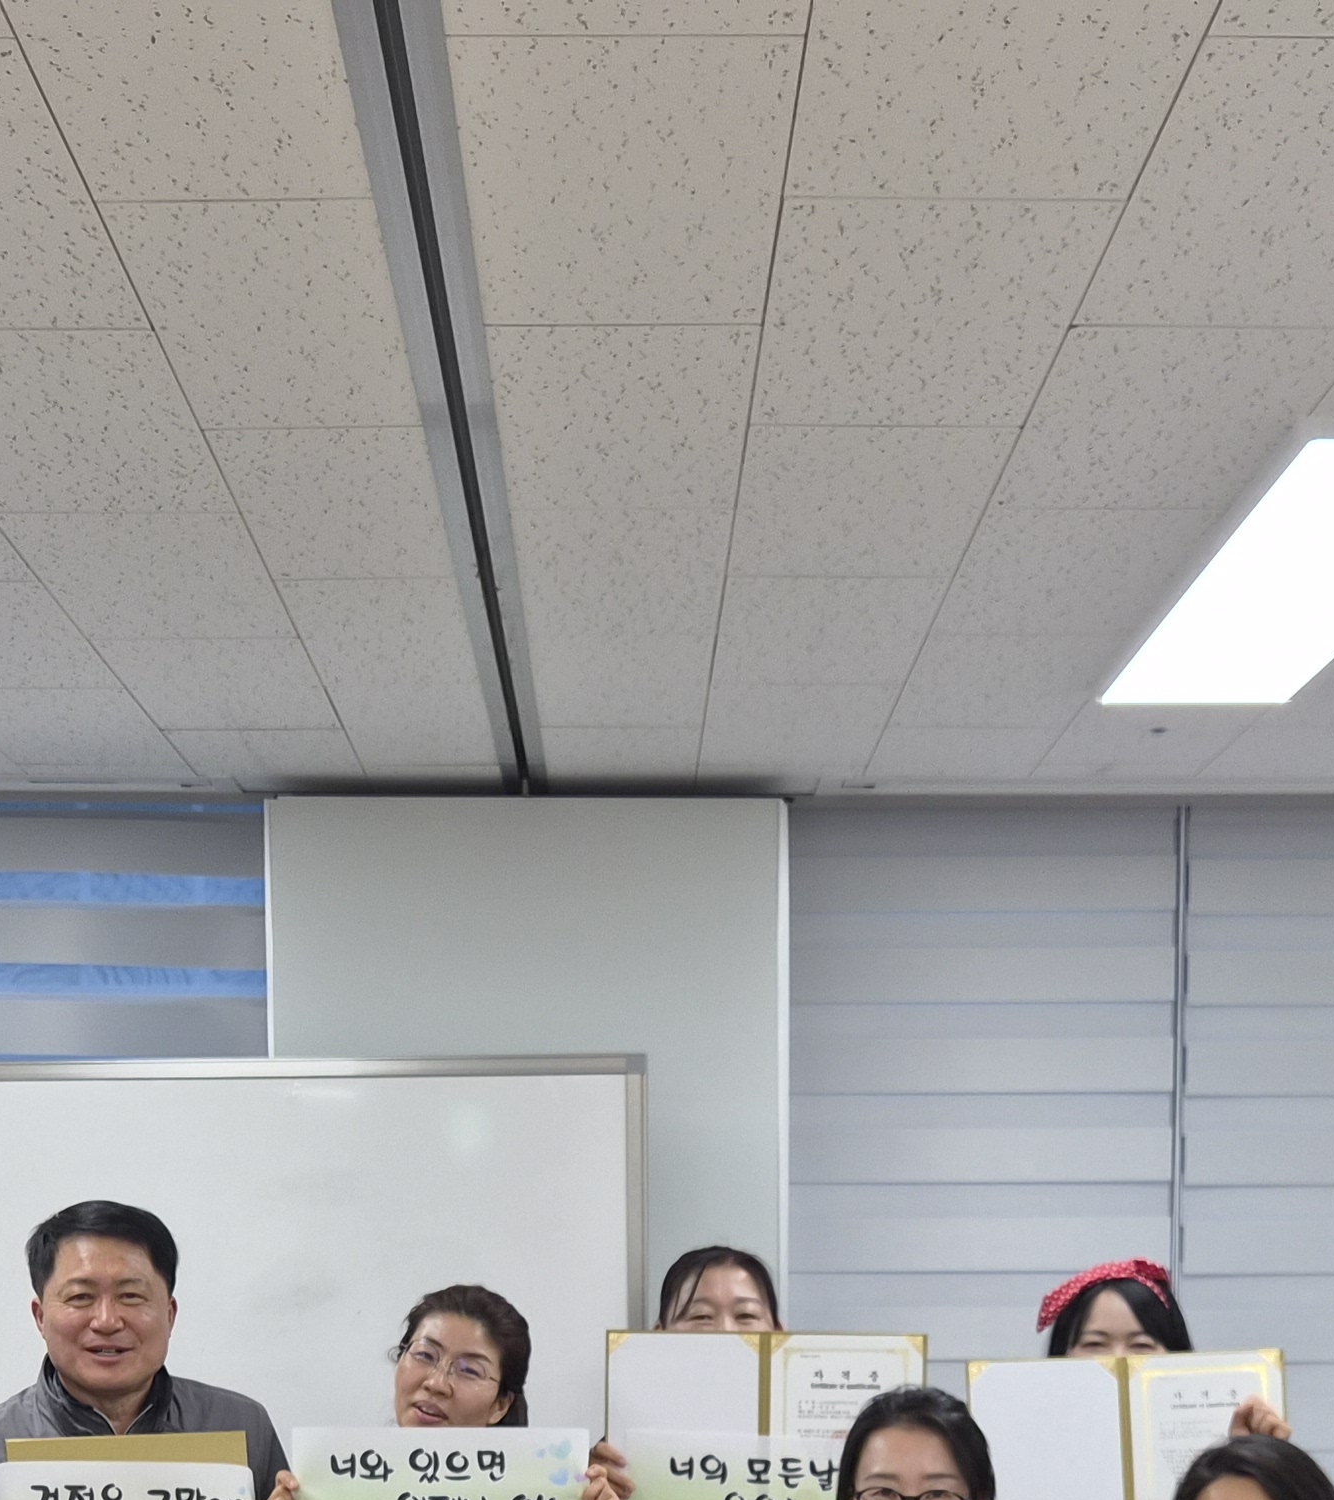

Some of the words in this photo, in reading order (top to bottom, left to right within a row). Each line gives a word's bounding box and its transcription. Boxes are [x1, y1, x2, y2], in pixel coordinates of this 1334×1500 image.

[330, 1449, 395, 1483] 너와
[408, 1447, 506, 1484] 있으면
[669, 1454, 728, 1485] 너의
